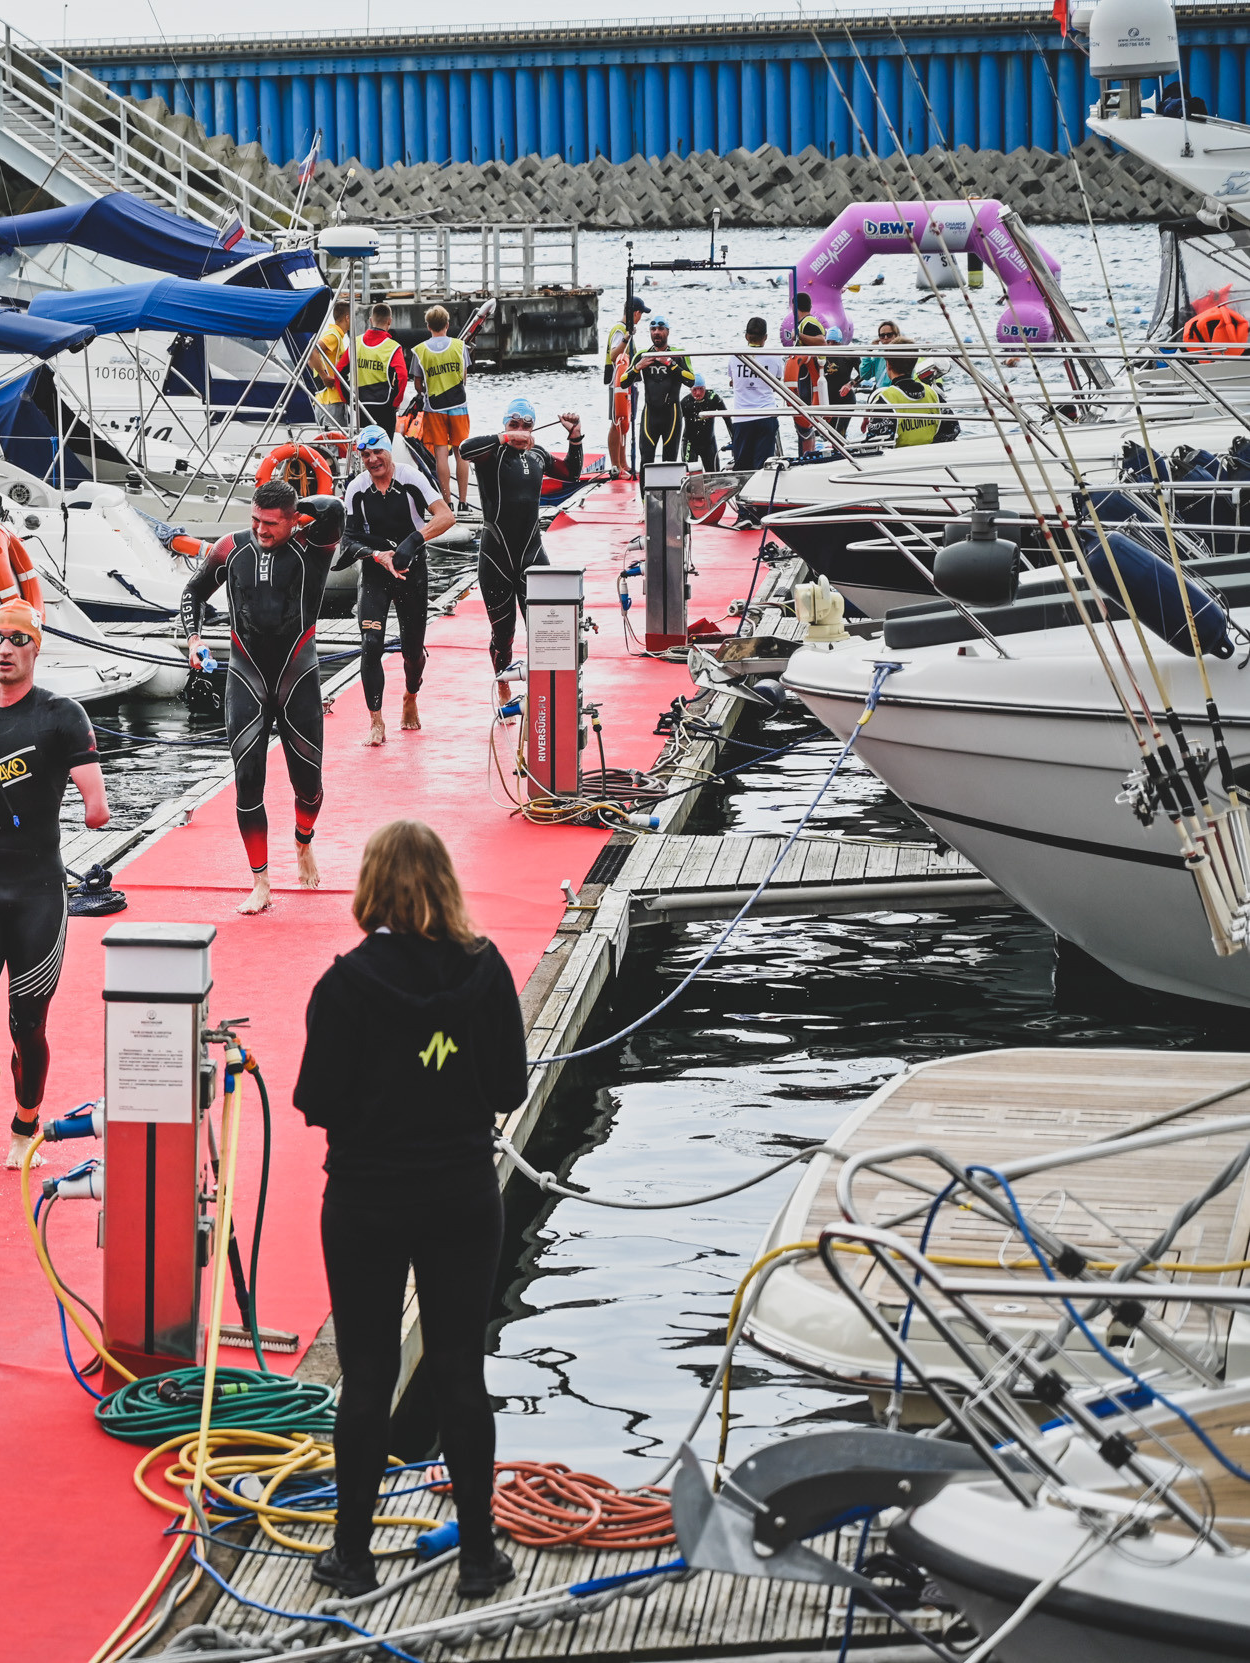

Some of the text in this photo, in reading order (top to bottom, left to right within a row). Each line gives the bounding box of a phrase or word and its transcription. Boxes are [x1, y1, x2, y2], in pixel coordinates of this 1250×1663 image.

[879, 221, 914, 235] BWT
[988, 228, 1010, 249] IRON
[810, 230, 851, 273] IRON STAR
[650, 365, 668, 374] TYR
[737, 364, 770, 378] TEA
